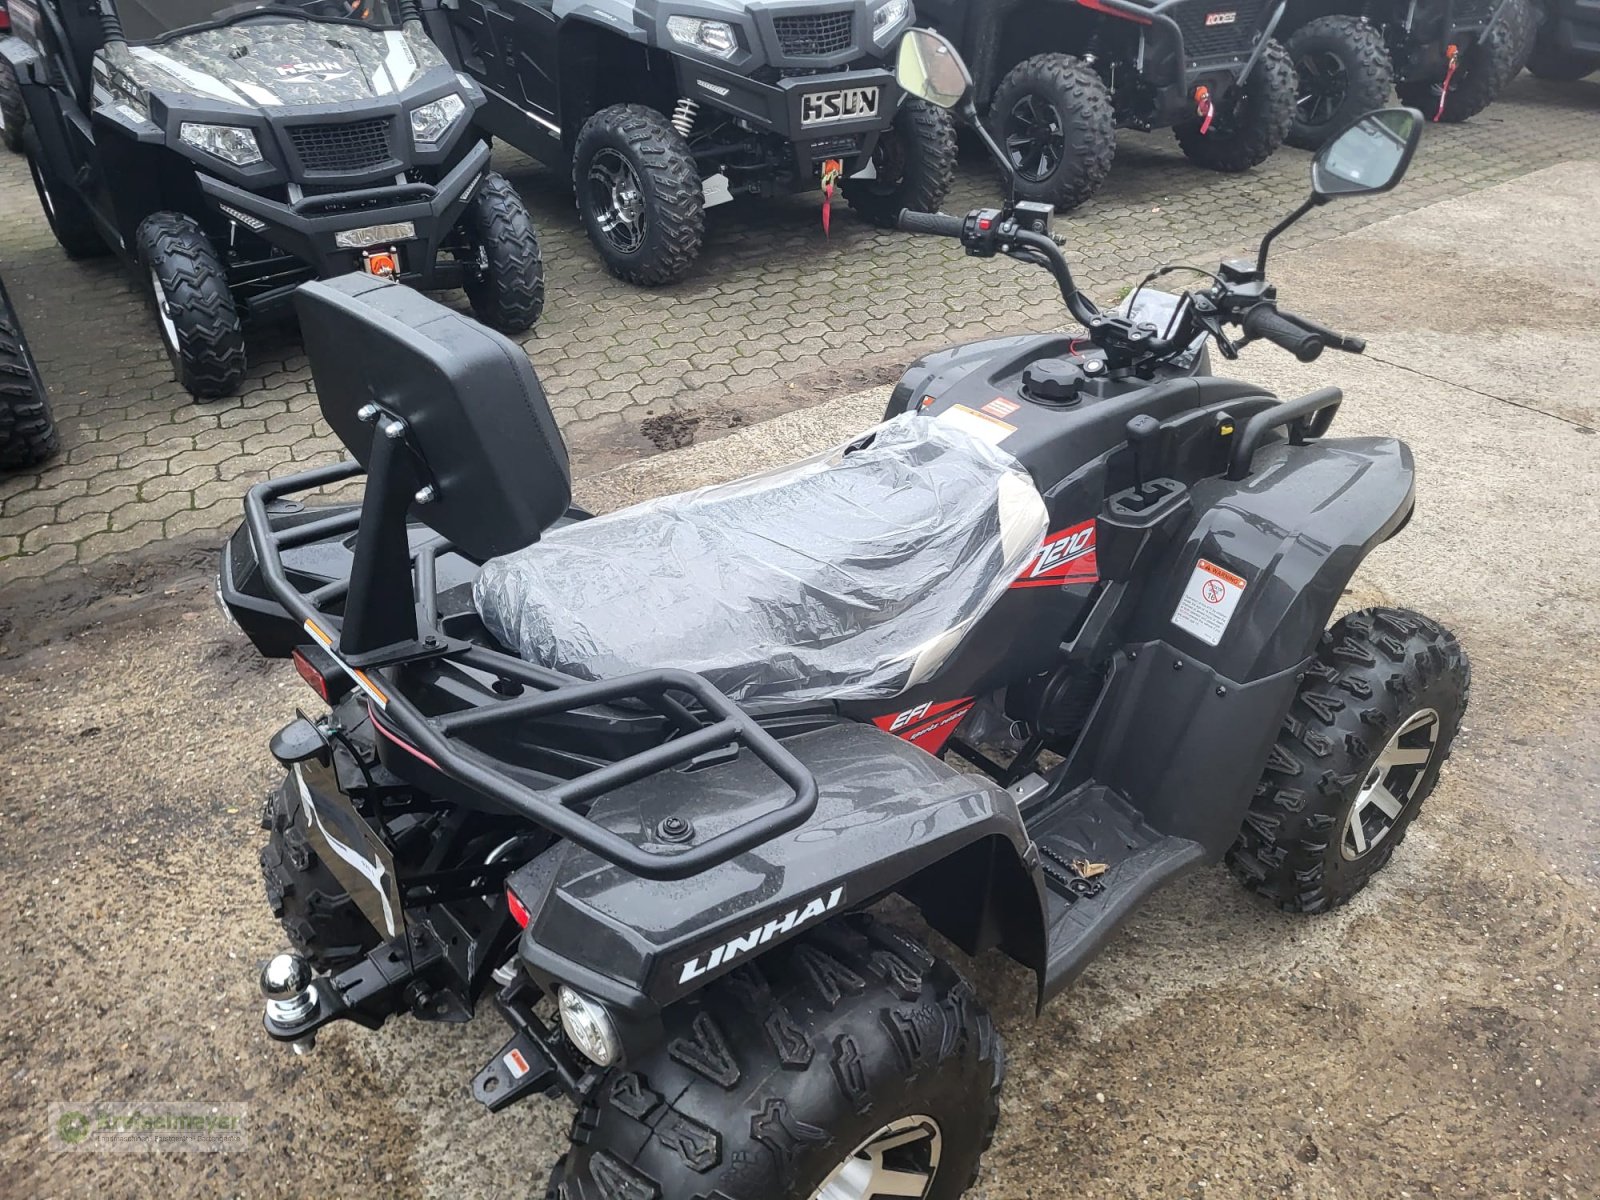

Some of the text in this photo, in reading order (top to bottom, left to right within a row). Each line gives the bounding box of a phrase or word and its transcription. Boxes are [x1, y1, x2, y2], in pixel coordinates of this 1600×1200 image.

[276, 62, 343, 75] HSUN
[121, 78, 137, 96] 250
[803, 89, 877, 121] HSUN
[679, 886, 843, 984] LINHAI
